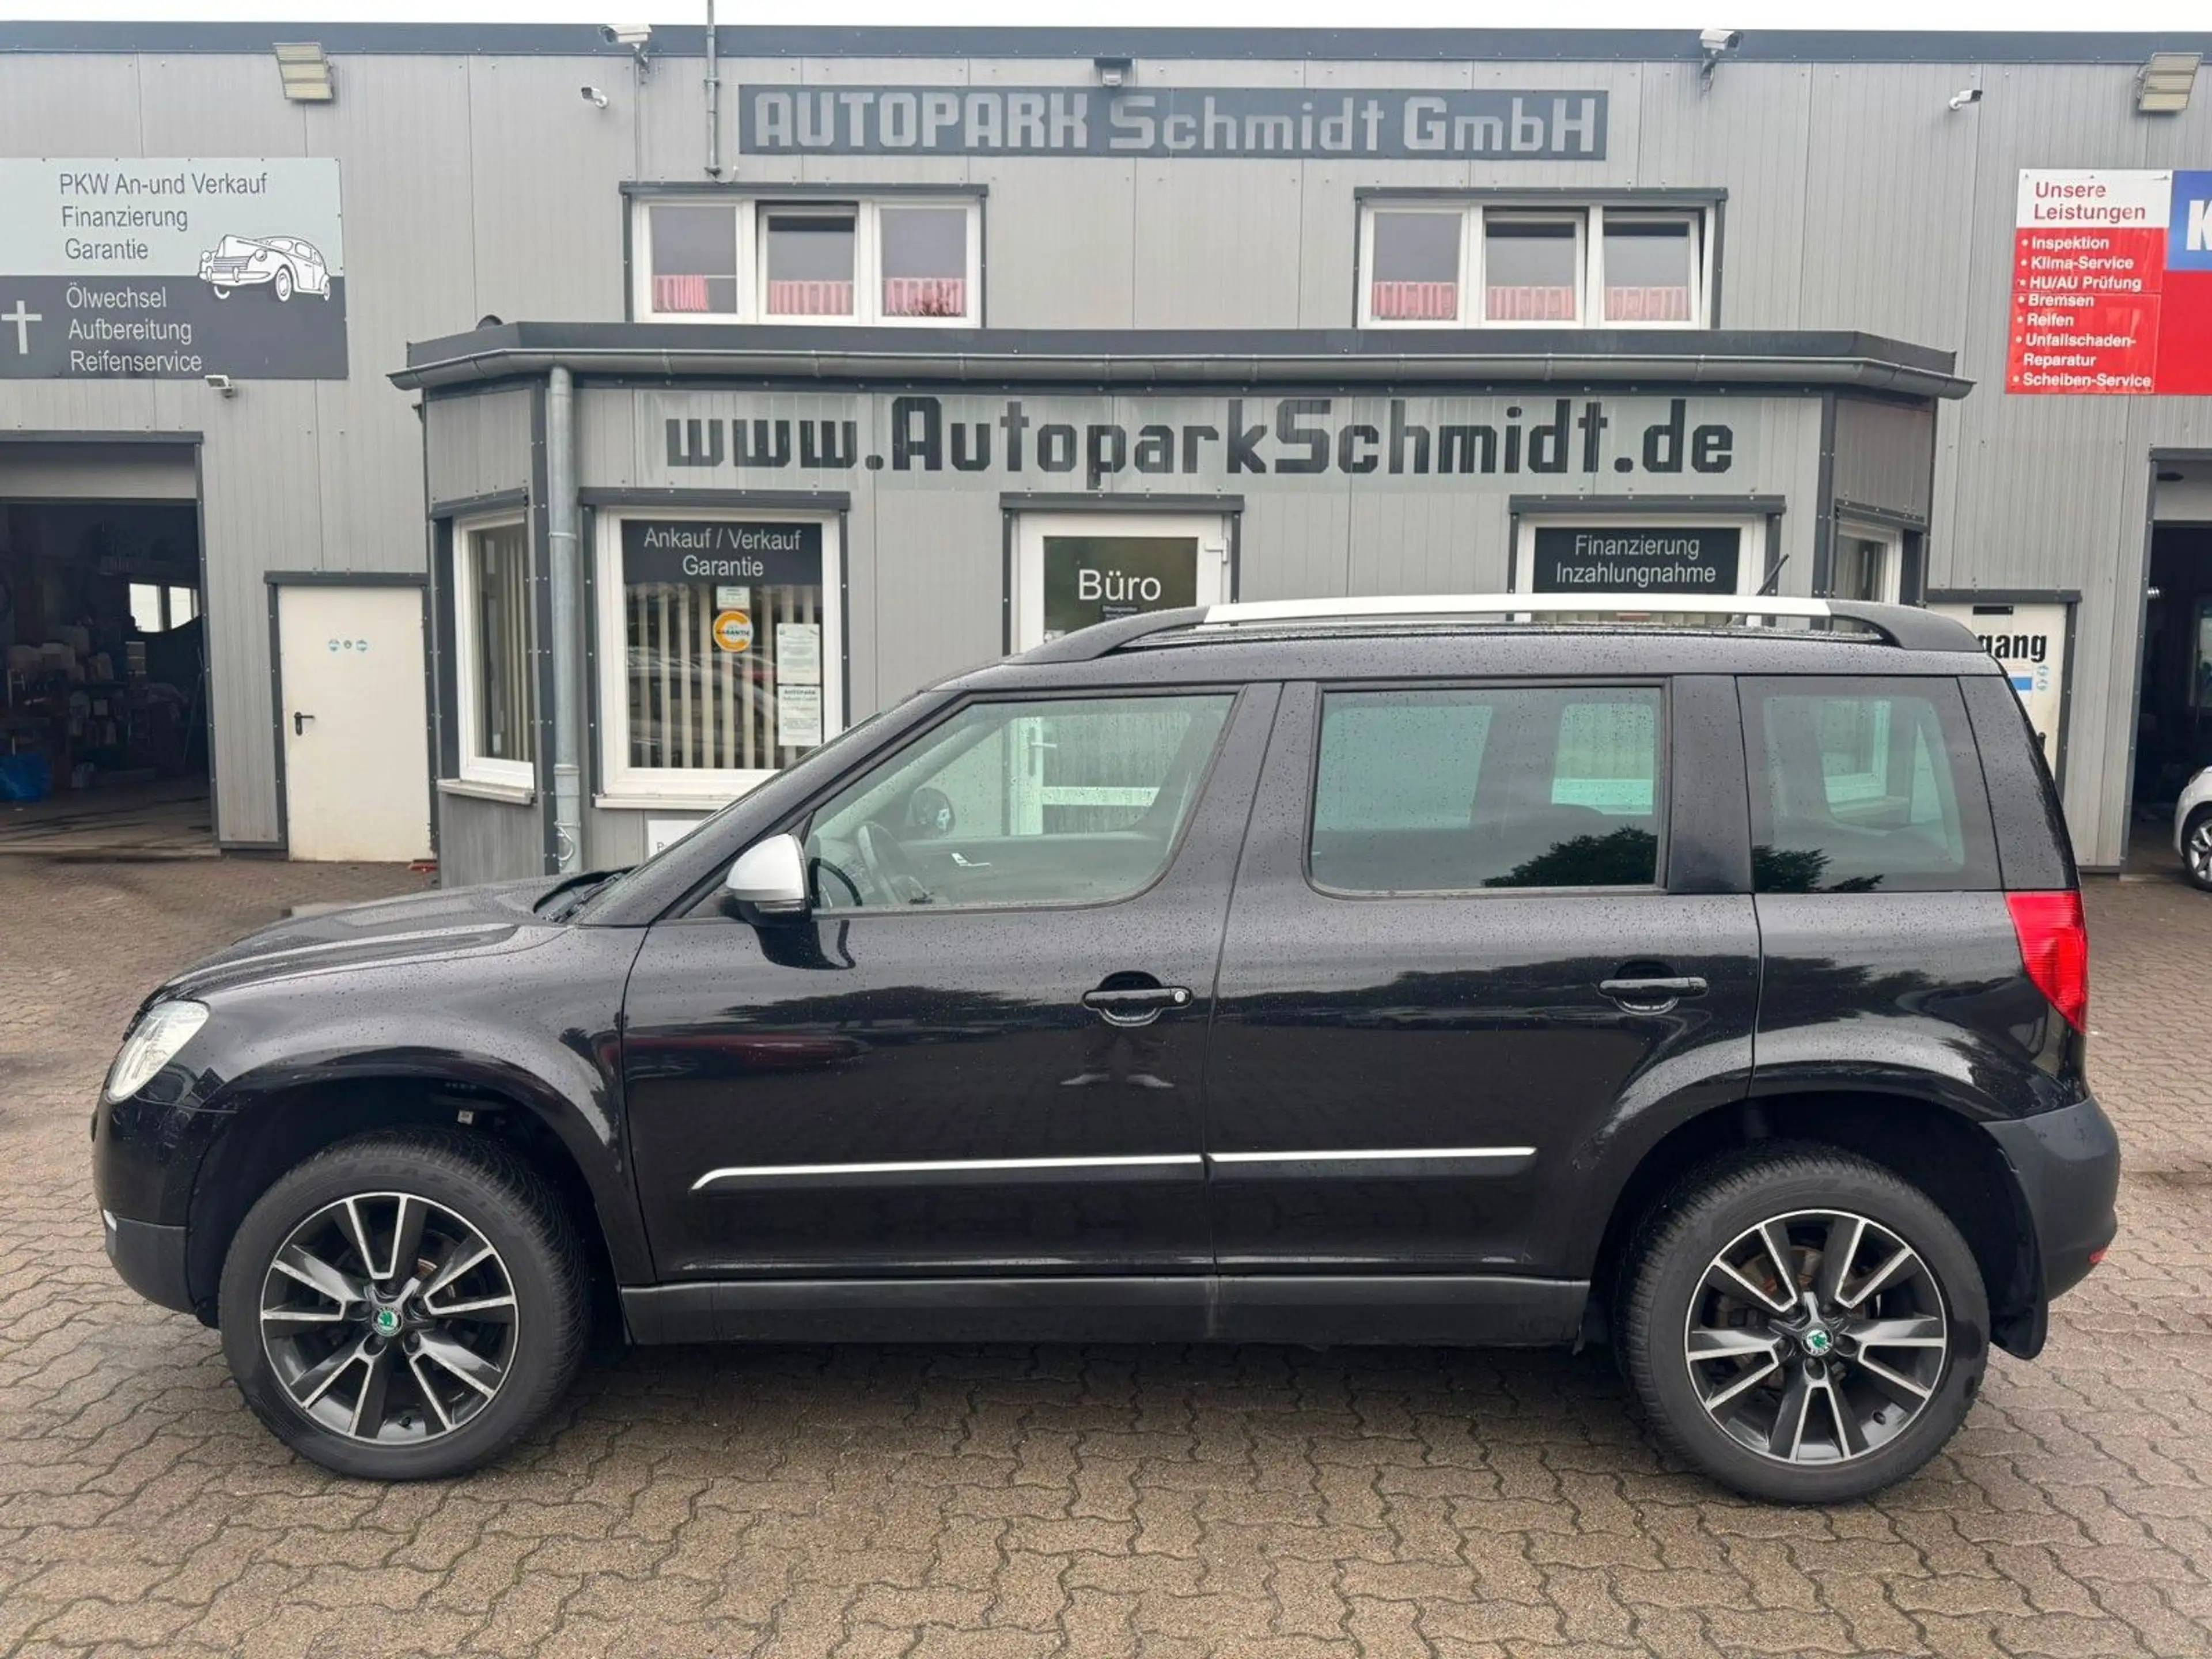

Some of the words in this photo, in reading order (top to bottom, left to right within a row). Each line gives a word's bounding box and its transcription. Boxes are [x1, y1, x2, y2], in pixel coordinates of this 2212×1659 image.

[755, 92, 1088, 147] AUTOPARK
[1109, 95, 1383, 150] Schmidt
[1404, 96, 1595, 152] GmbH
[59, 173, 109, 195] PKW
[115, 173, 185, 195] An-und
[192, 172, 267, 195] Verkauf
[2035, 181, 2107, 198] Unsere
[62, 206, 188, 232] Finanzierung
[2034, 203, 2146, 224] Leistungen
[65, 238, 148, 260] Garantie
[2032, 236, 2109, 252] Inspektion
[2031, 256, 2134, 270] Klima-Service
[66, 282, 166, 308] Ölwechsel
[2029, 276, 2078, 289] HU/AU
[2082, 275, 2142, 293] Prüfung
[2028, 294, 2094, 307] Bremsen
[2027, 314, 2074, 327] Reifen
[69, 319, 192, 345] Aufbereitung
[2025, 333, 2136, 347] Unfallschaden-
[70, 350, 202, 372] Reifenservice
[2024, 353, 2096, 368] Reparatur
[2022, 372, 2153, 388] Scheiben-Service
[666, 396, 1733, 490] www.AutoparkSchmidt.de
[644, 527, 712, 548] Ankauf
[729, 528, 801, 550] Verkauf
[1575, 535, 1700, 560] Finanzierung
[682, 555, 764, 577] Garantie
[1556, 562, 1716, 588] Inzahlungnahme
[1079, 569, 1161, 601] Büro
